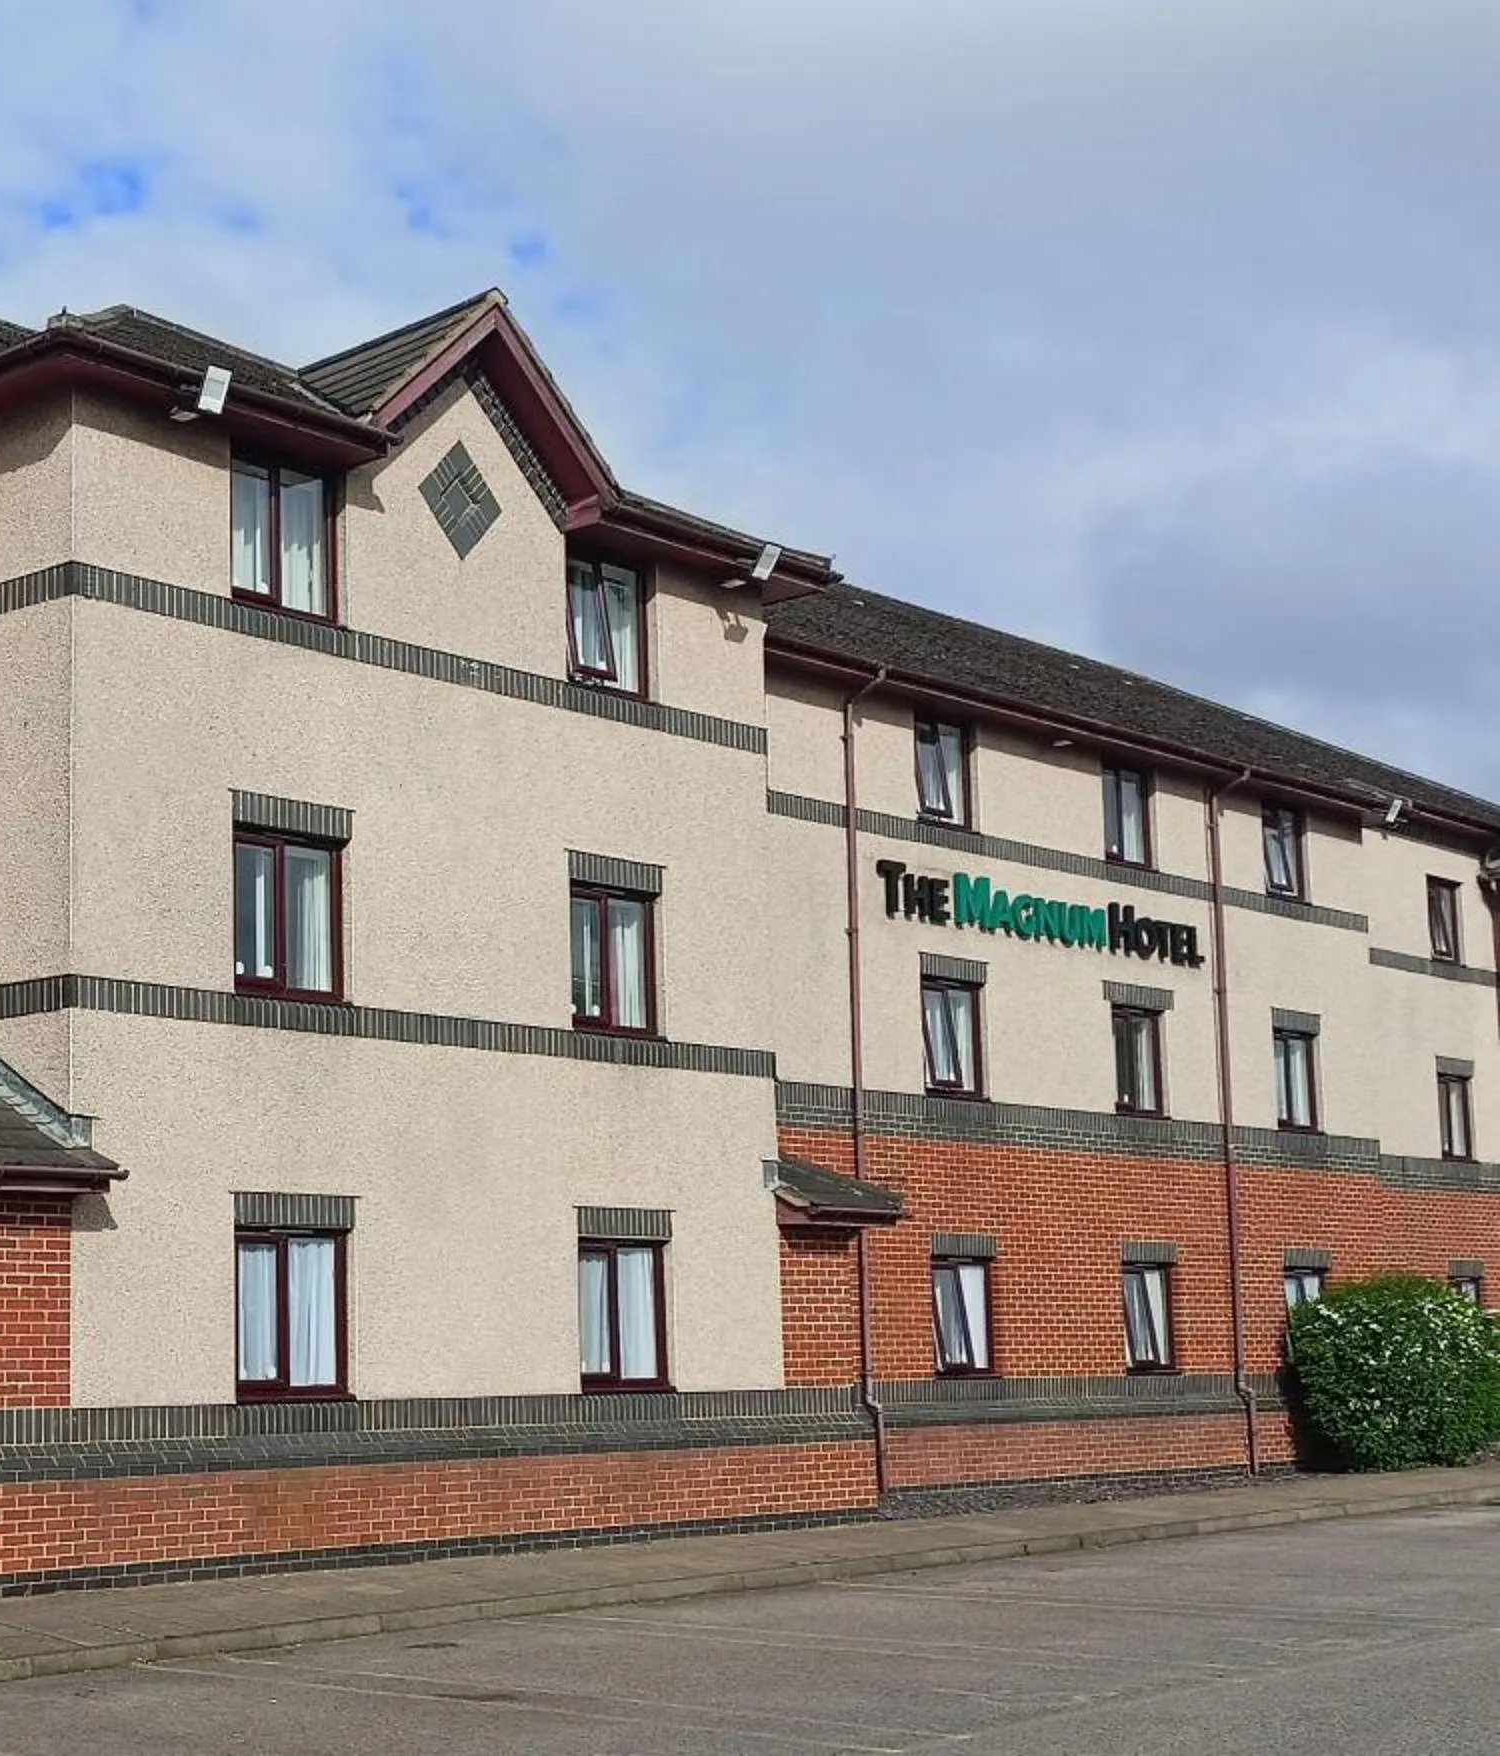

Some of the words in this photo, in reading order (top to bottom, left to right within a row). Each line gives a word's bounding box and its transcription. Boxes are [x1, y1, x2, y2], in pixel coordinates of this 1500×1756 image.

[876, 859, 950, 926] THE
[953, 872, 1106, 953] MAGNUM
[1107, 902, 1205, 968] HOTEL
